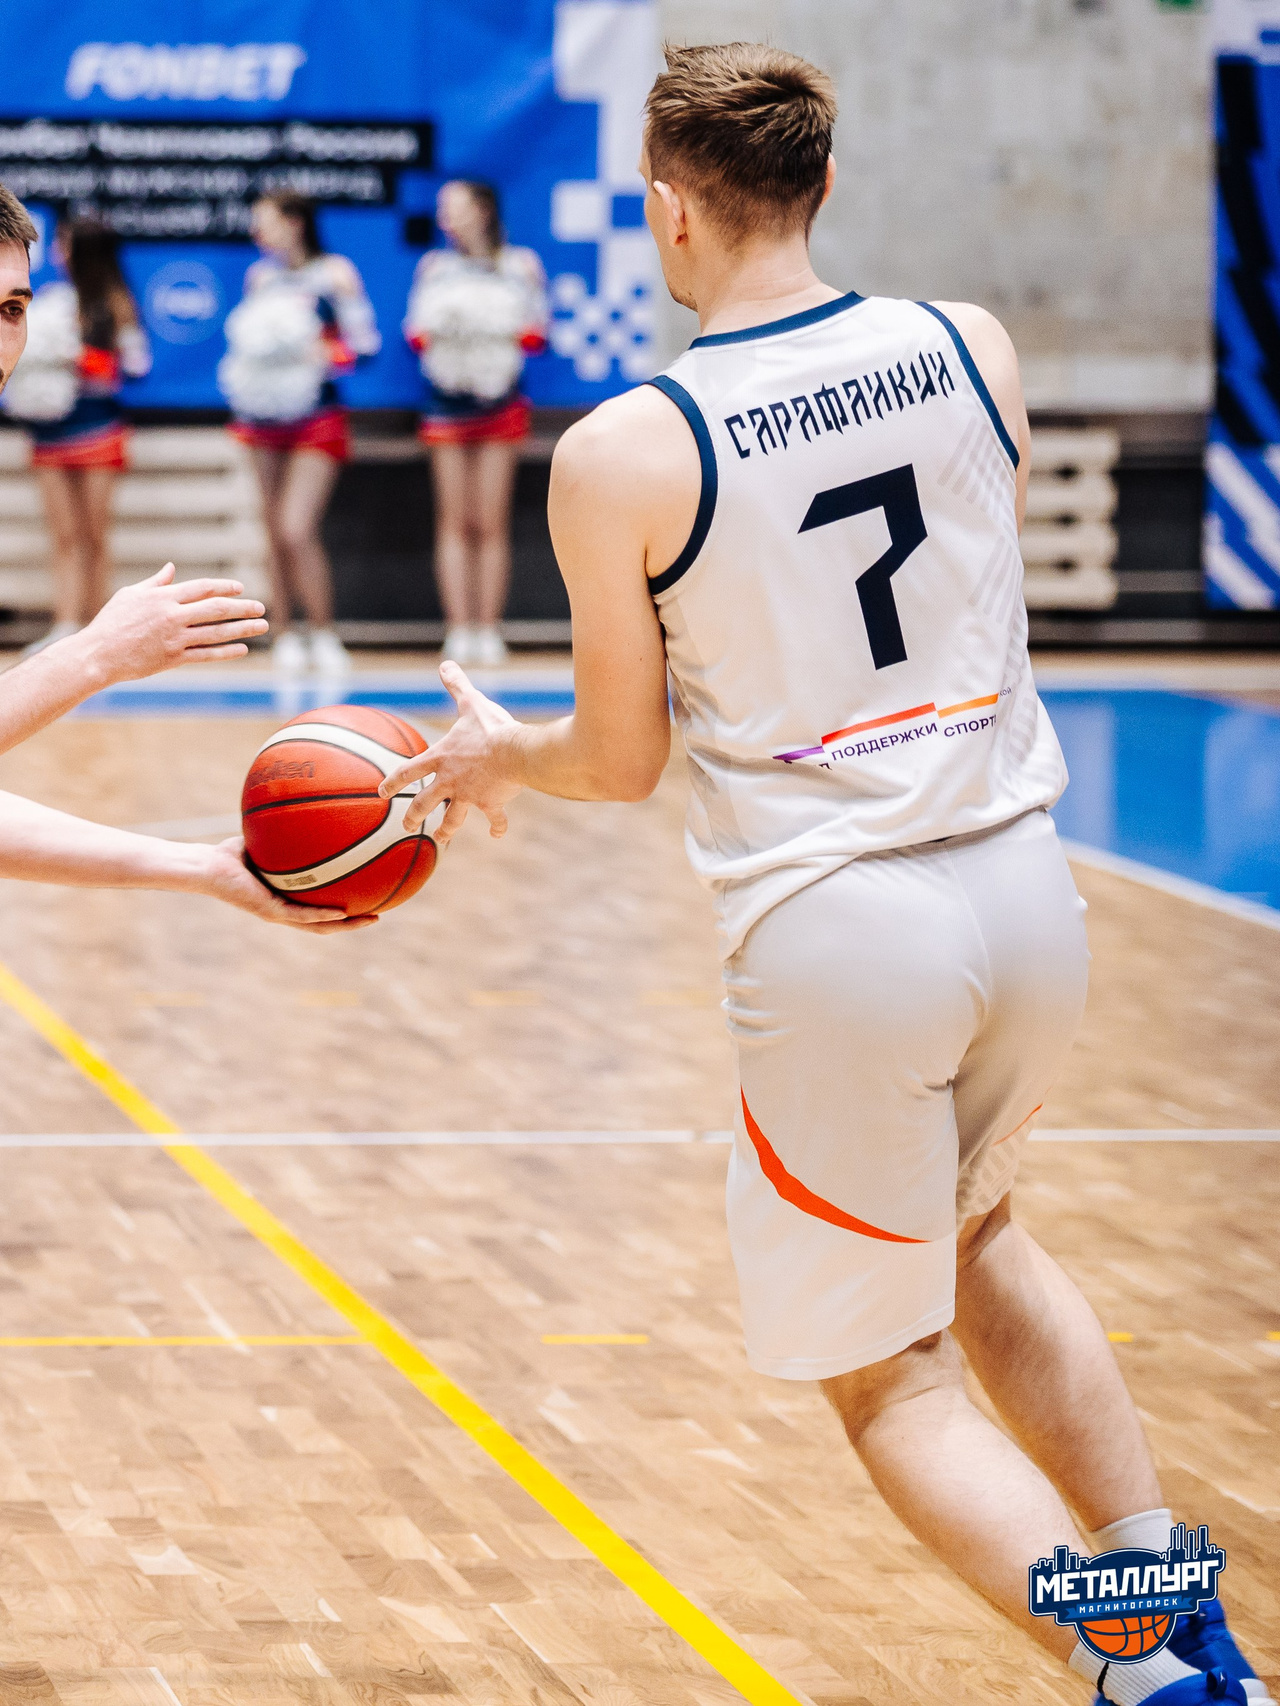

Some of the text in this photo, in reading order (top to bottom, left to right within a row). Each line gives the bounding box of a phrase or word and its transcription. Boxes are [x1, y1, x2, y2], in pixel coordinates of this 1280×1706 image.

[65, 42, 305, 101] FONBET
[724, 351, 955, 459] САРАФАНКИН
[798, 463, 928, 671] 7
[831, 714, 997, 761] ПОДДЕРЖКИ СПОРТ
